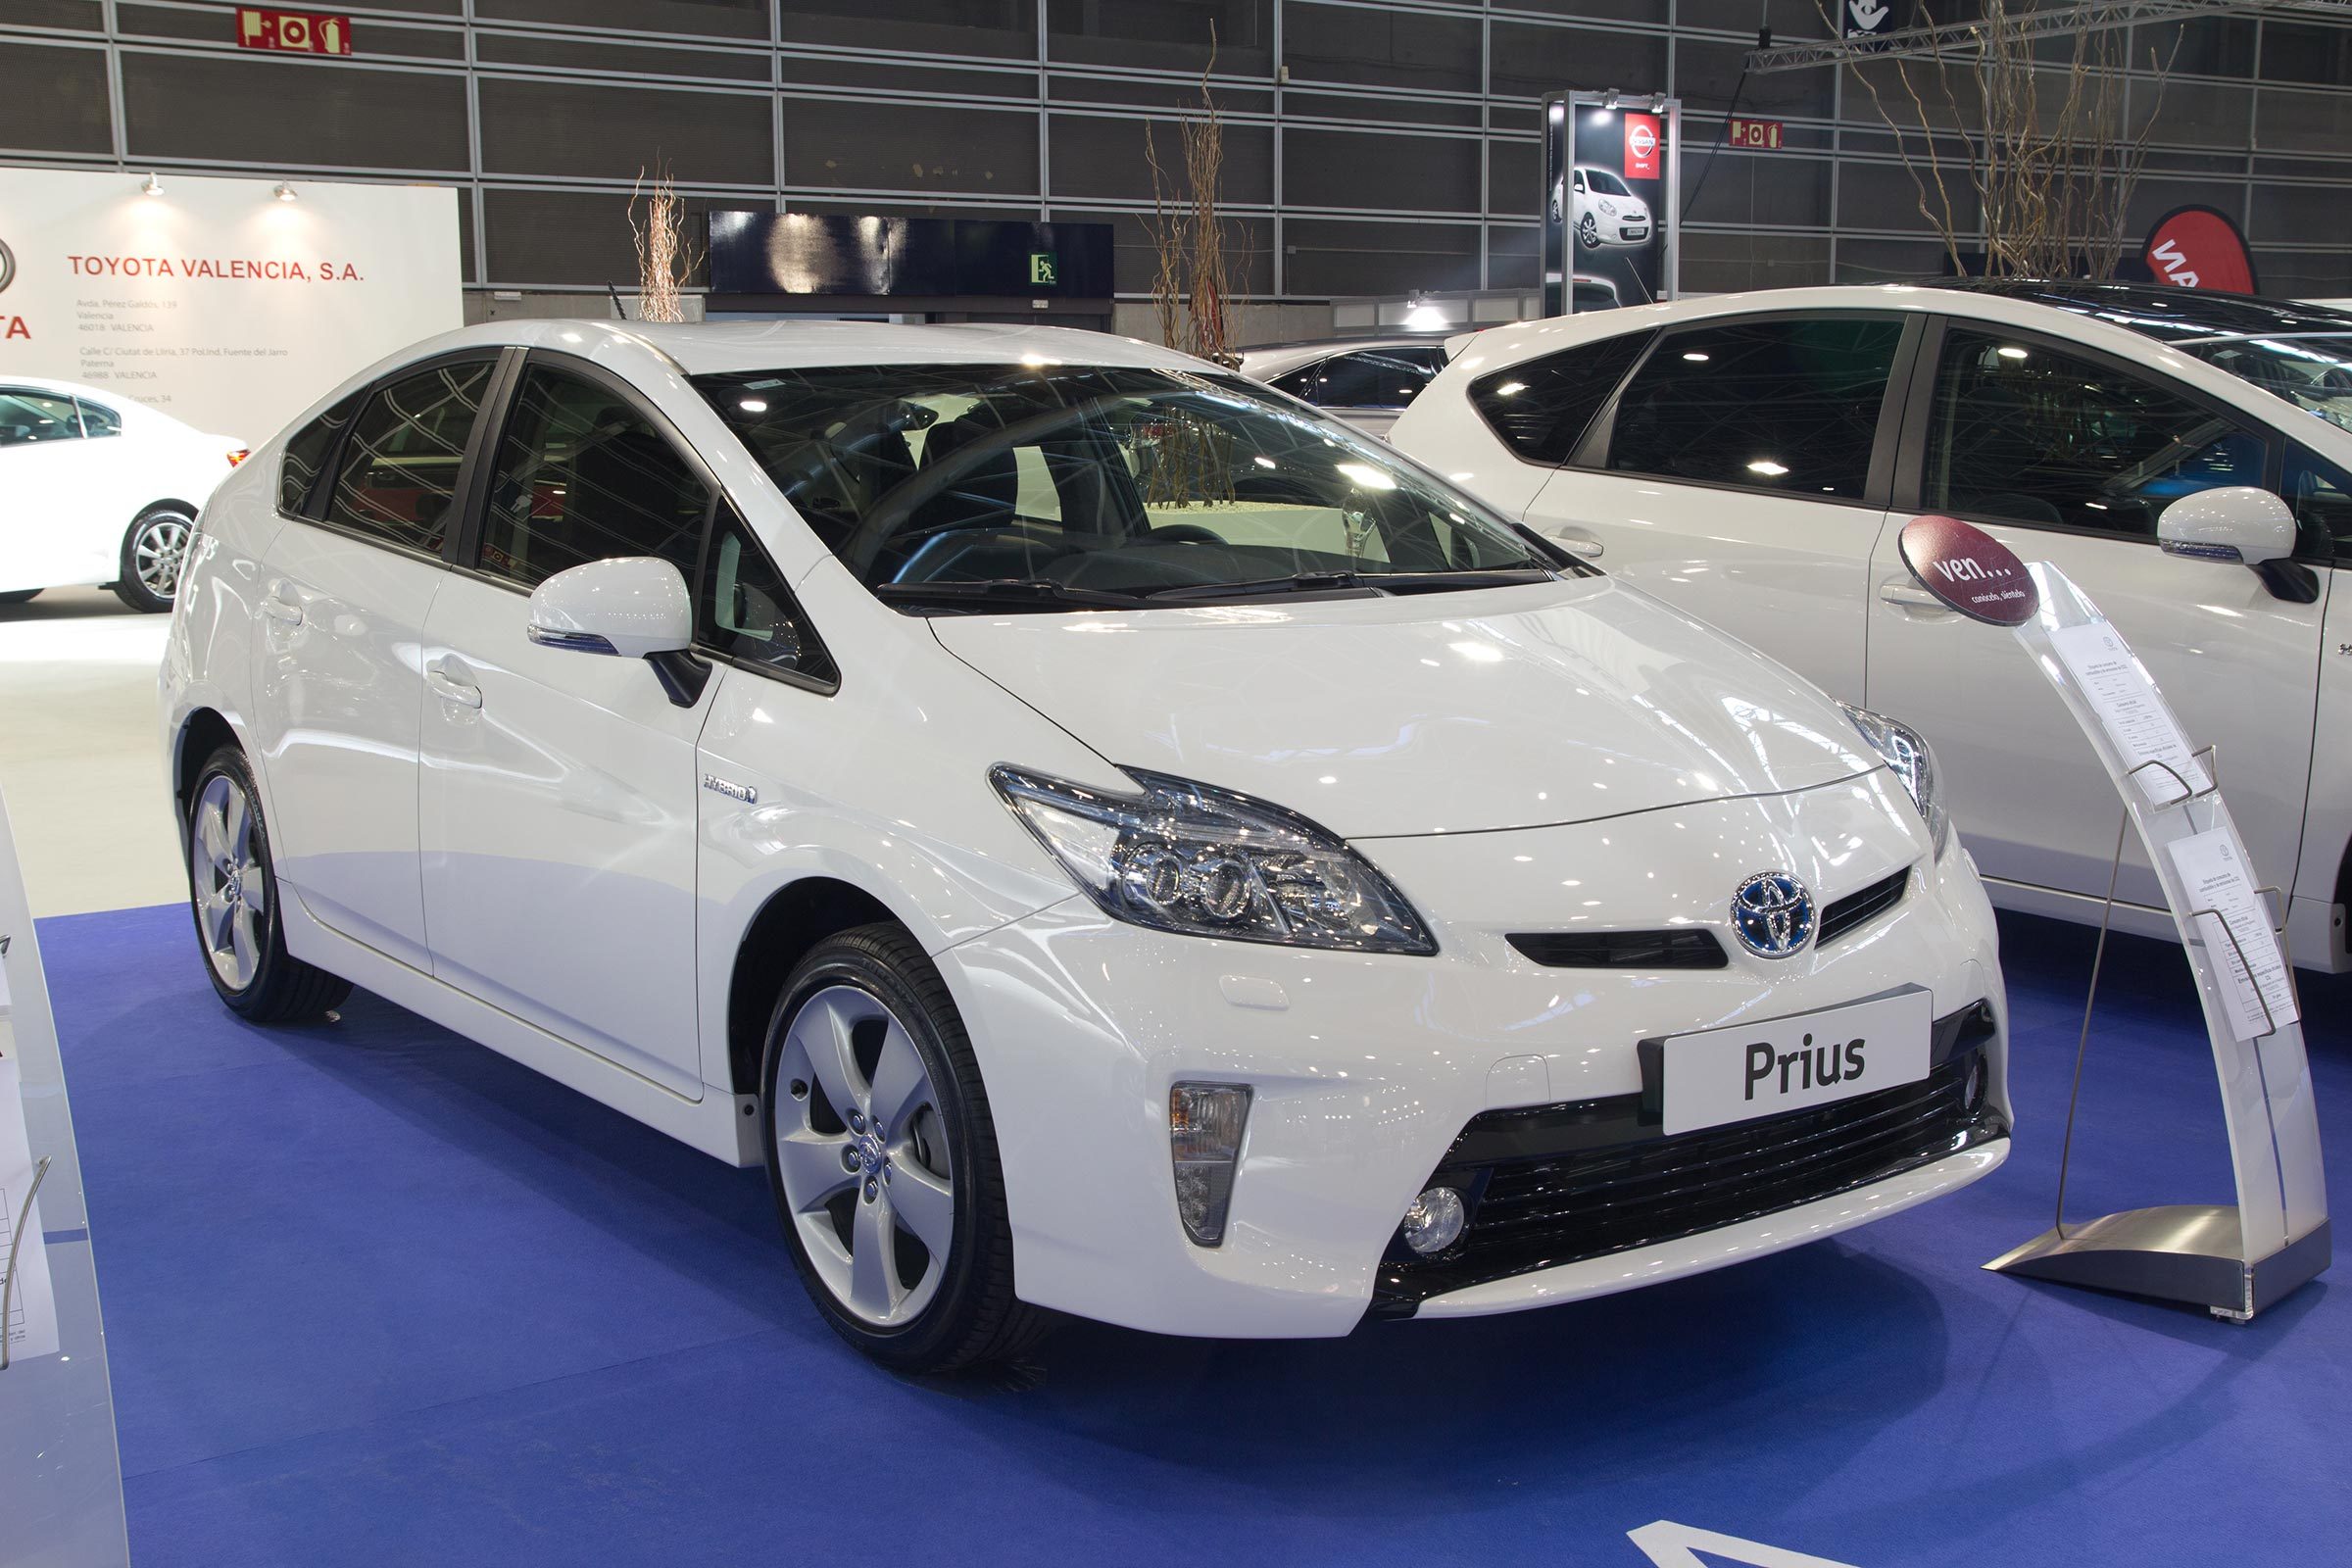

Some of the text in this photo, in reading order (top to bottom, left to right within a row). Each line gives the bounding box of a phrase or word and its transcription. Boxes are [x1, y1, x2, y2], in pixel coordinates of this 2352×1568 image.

[68, 256, 365, 282] TOYOTA VALENCIA, S.A.
[79, 346, 102, 356] Calle
[142, 347, 154, 356] de
[222, 347, 252, 356] Fuente
[254, 347, 267, 356] del
[80, 359, 115, 368] Paterna
[114, 370, 157, 379] VALENCIA
[1933, 557, 2012, 582] ven...
[704, 772, 747, 802] HYBRID
[1743, 1032, 1866, 1101] Prius
